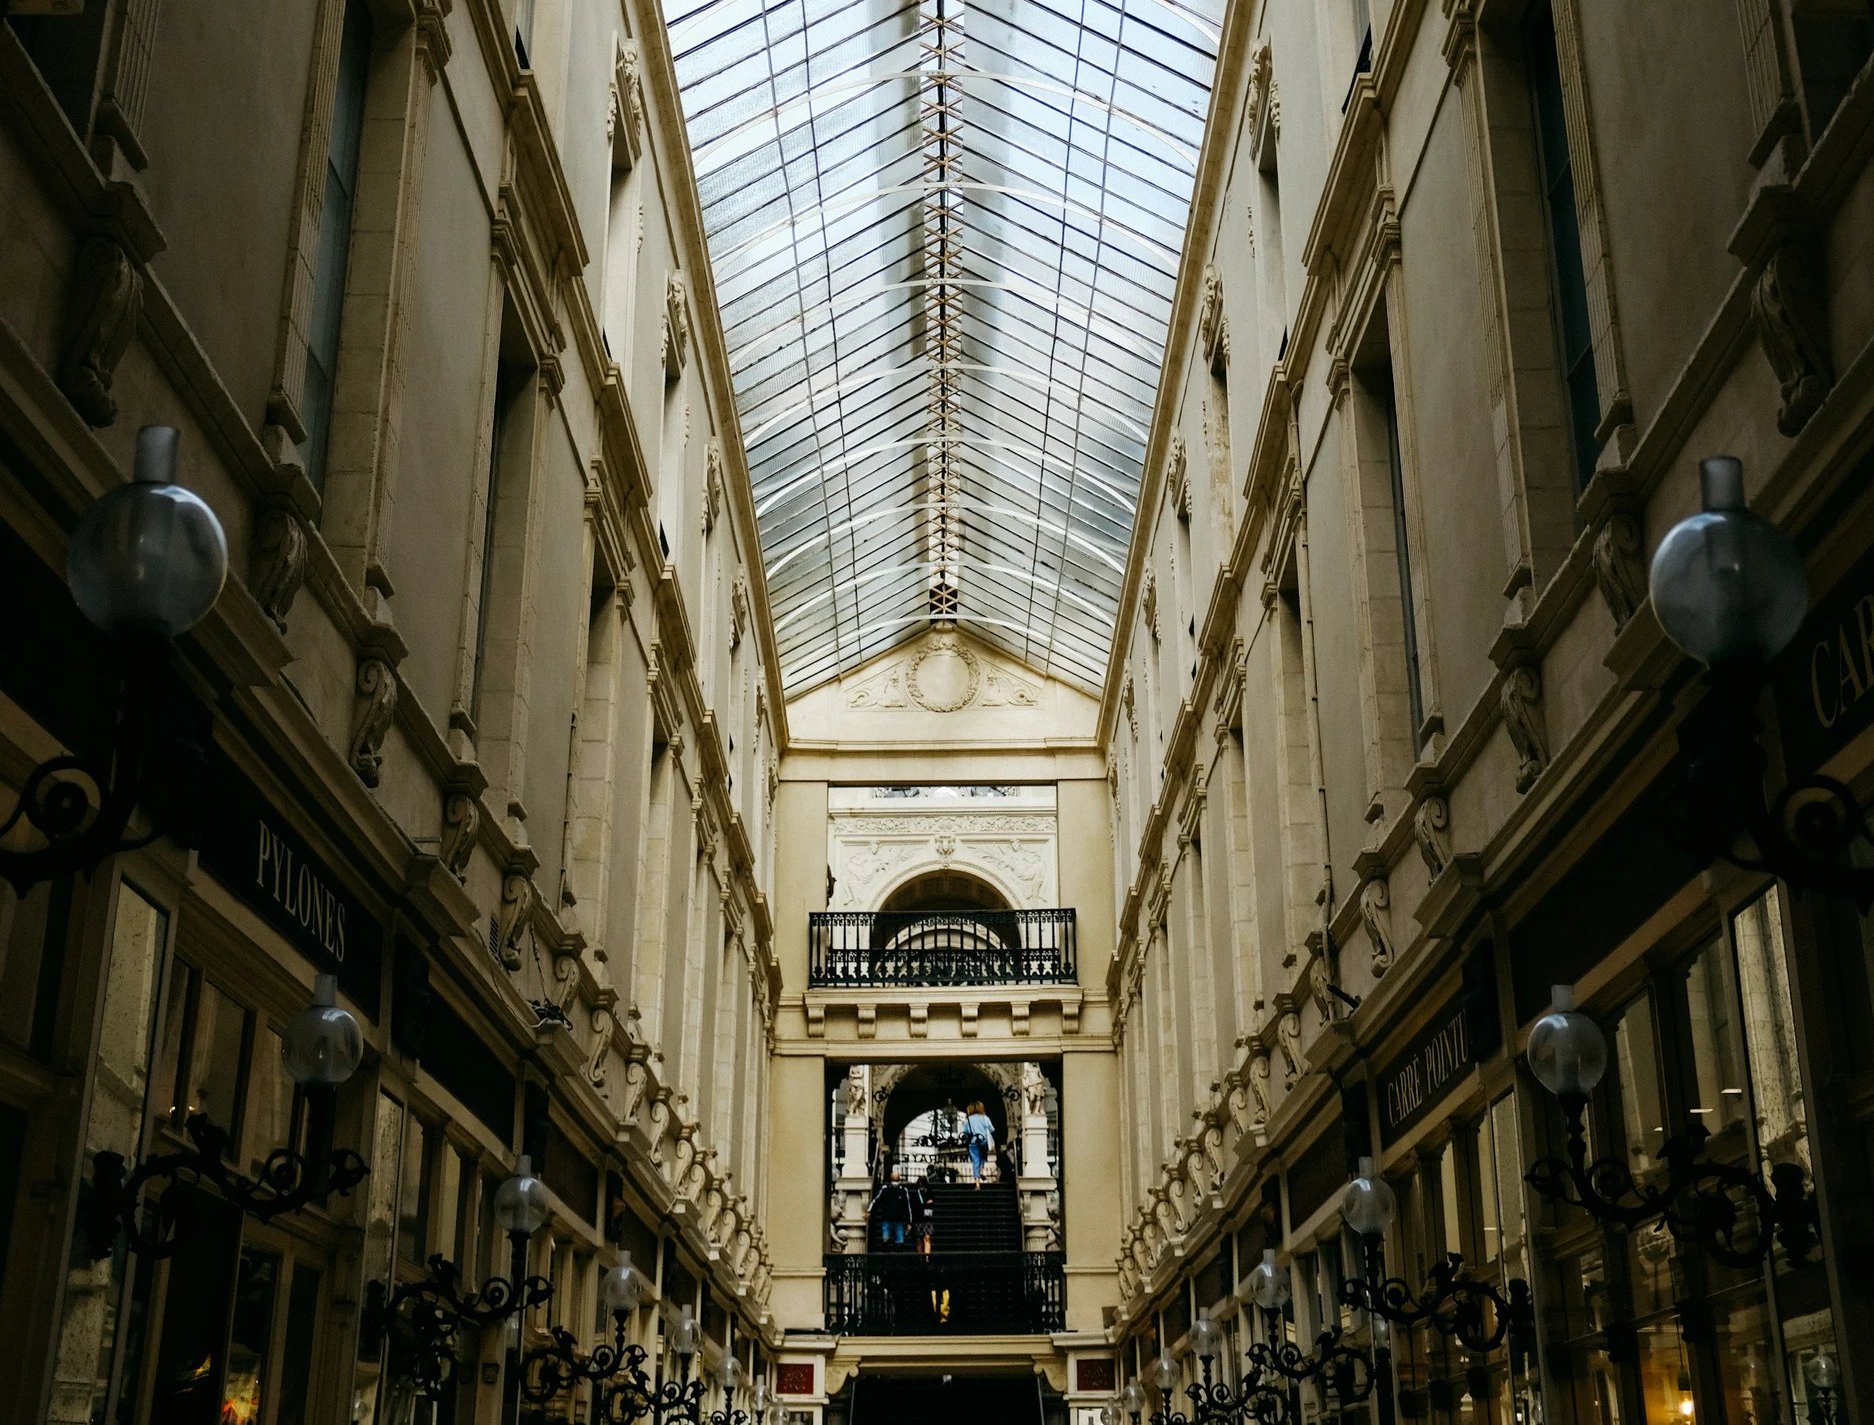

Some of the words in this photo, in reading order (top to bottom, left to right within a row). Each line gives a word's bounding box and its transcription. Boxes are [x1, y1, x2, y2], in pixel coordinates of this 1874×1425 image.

[256, 819, 346, 963] PYLONES
[1387, 1053, 1423, 1128] CARRÉ
[1424, 1008, 1469, 1096] POINTU
